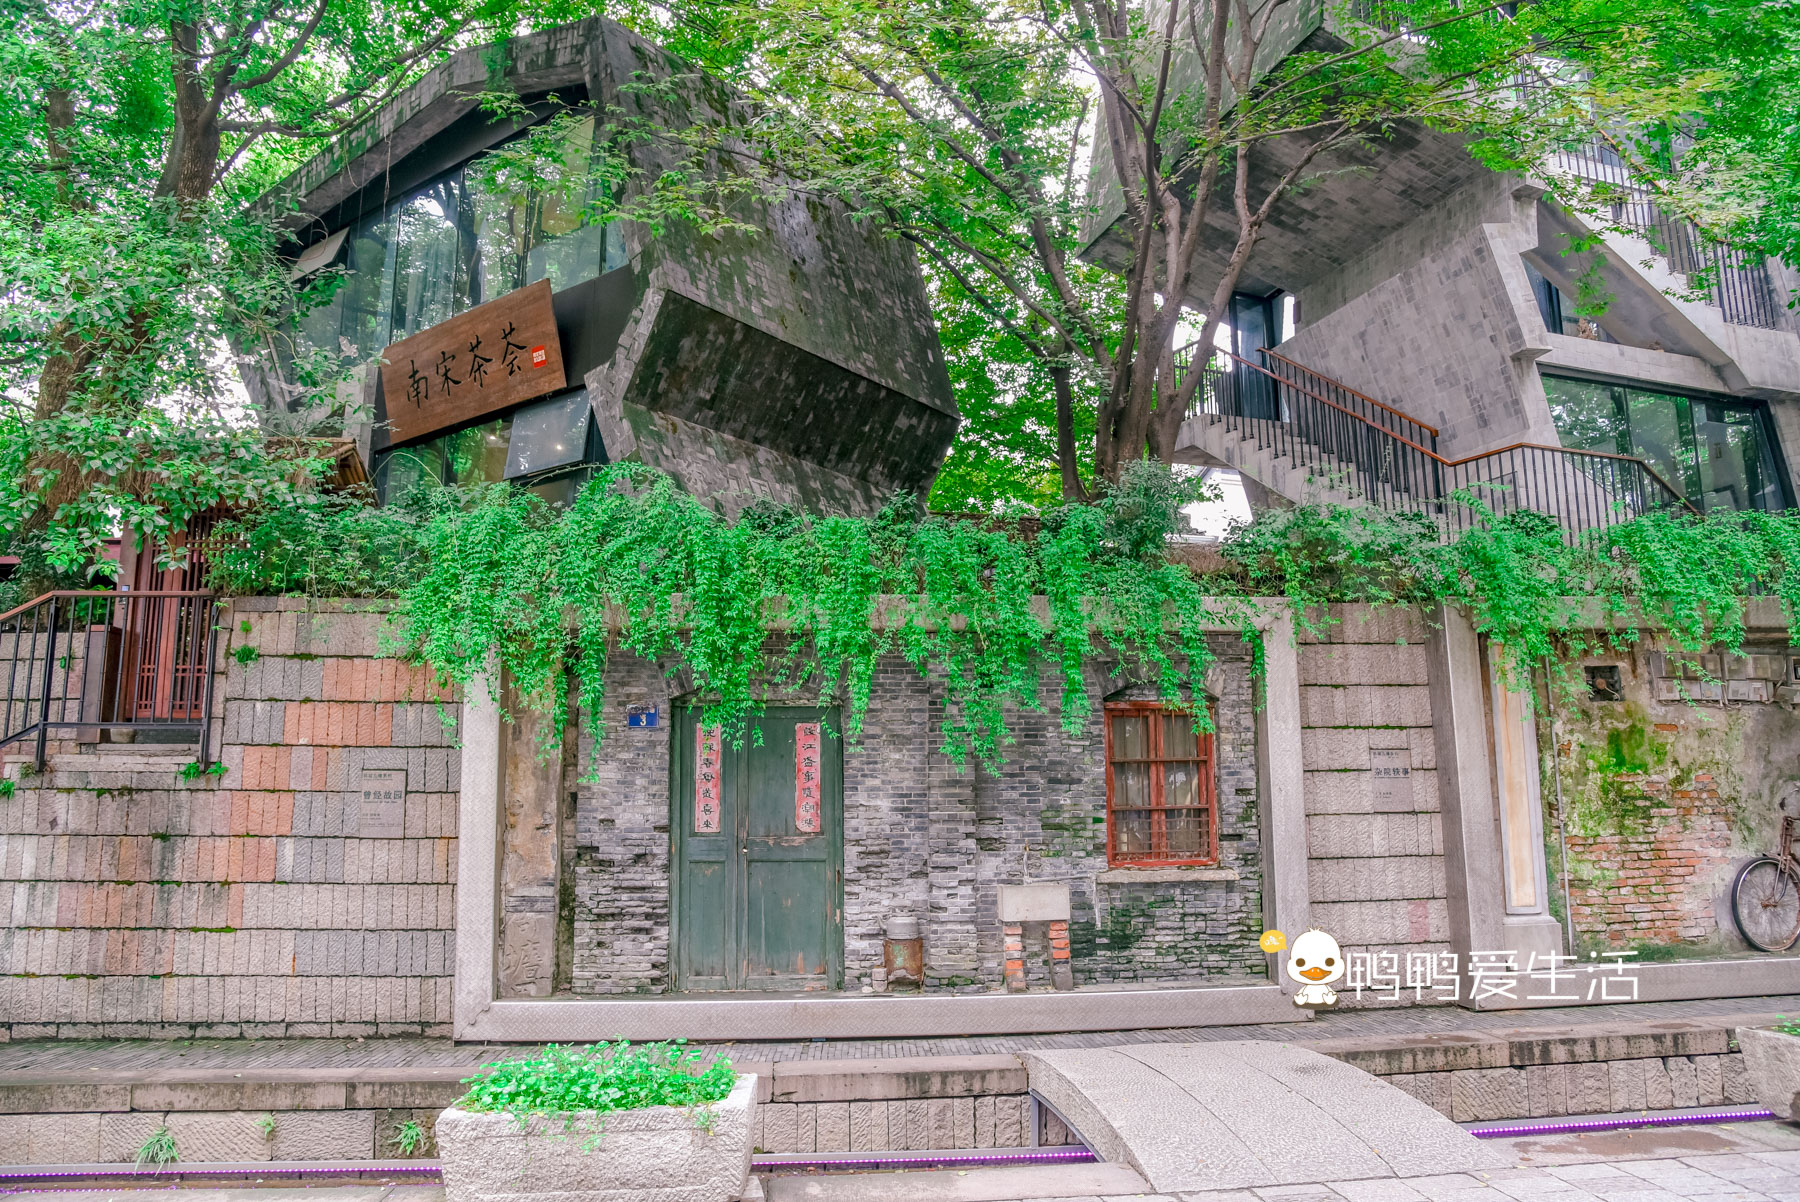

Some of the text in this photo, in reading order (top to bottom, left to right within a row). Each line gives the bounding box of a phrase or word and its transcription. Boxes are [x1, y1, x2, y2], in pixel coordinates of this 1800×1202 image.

[640, 714, 647, 726] 3
[1374, 767, 1409, 776] 杂院轶事
[363, 790, 402, 800] 曾经故园
